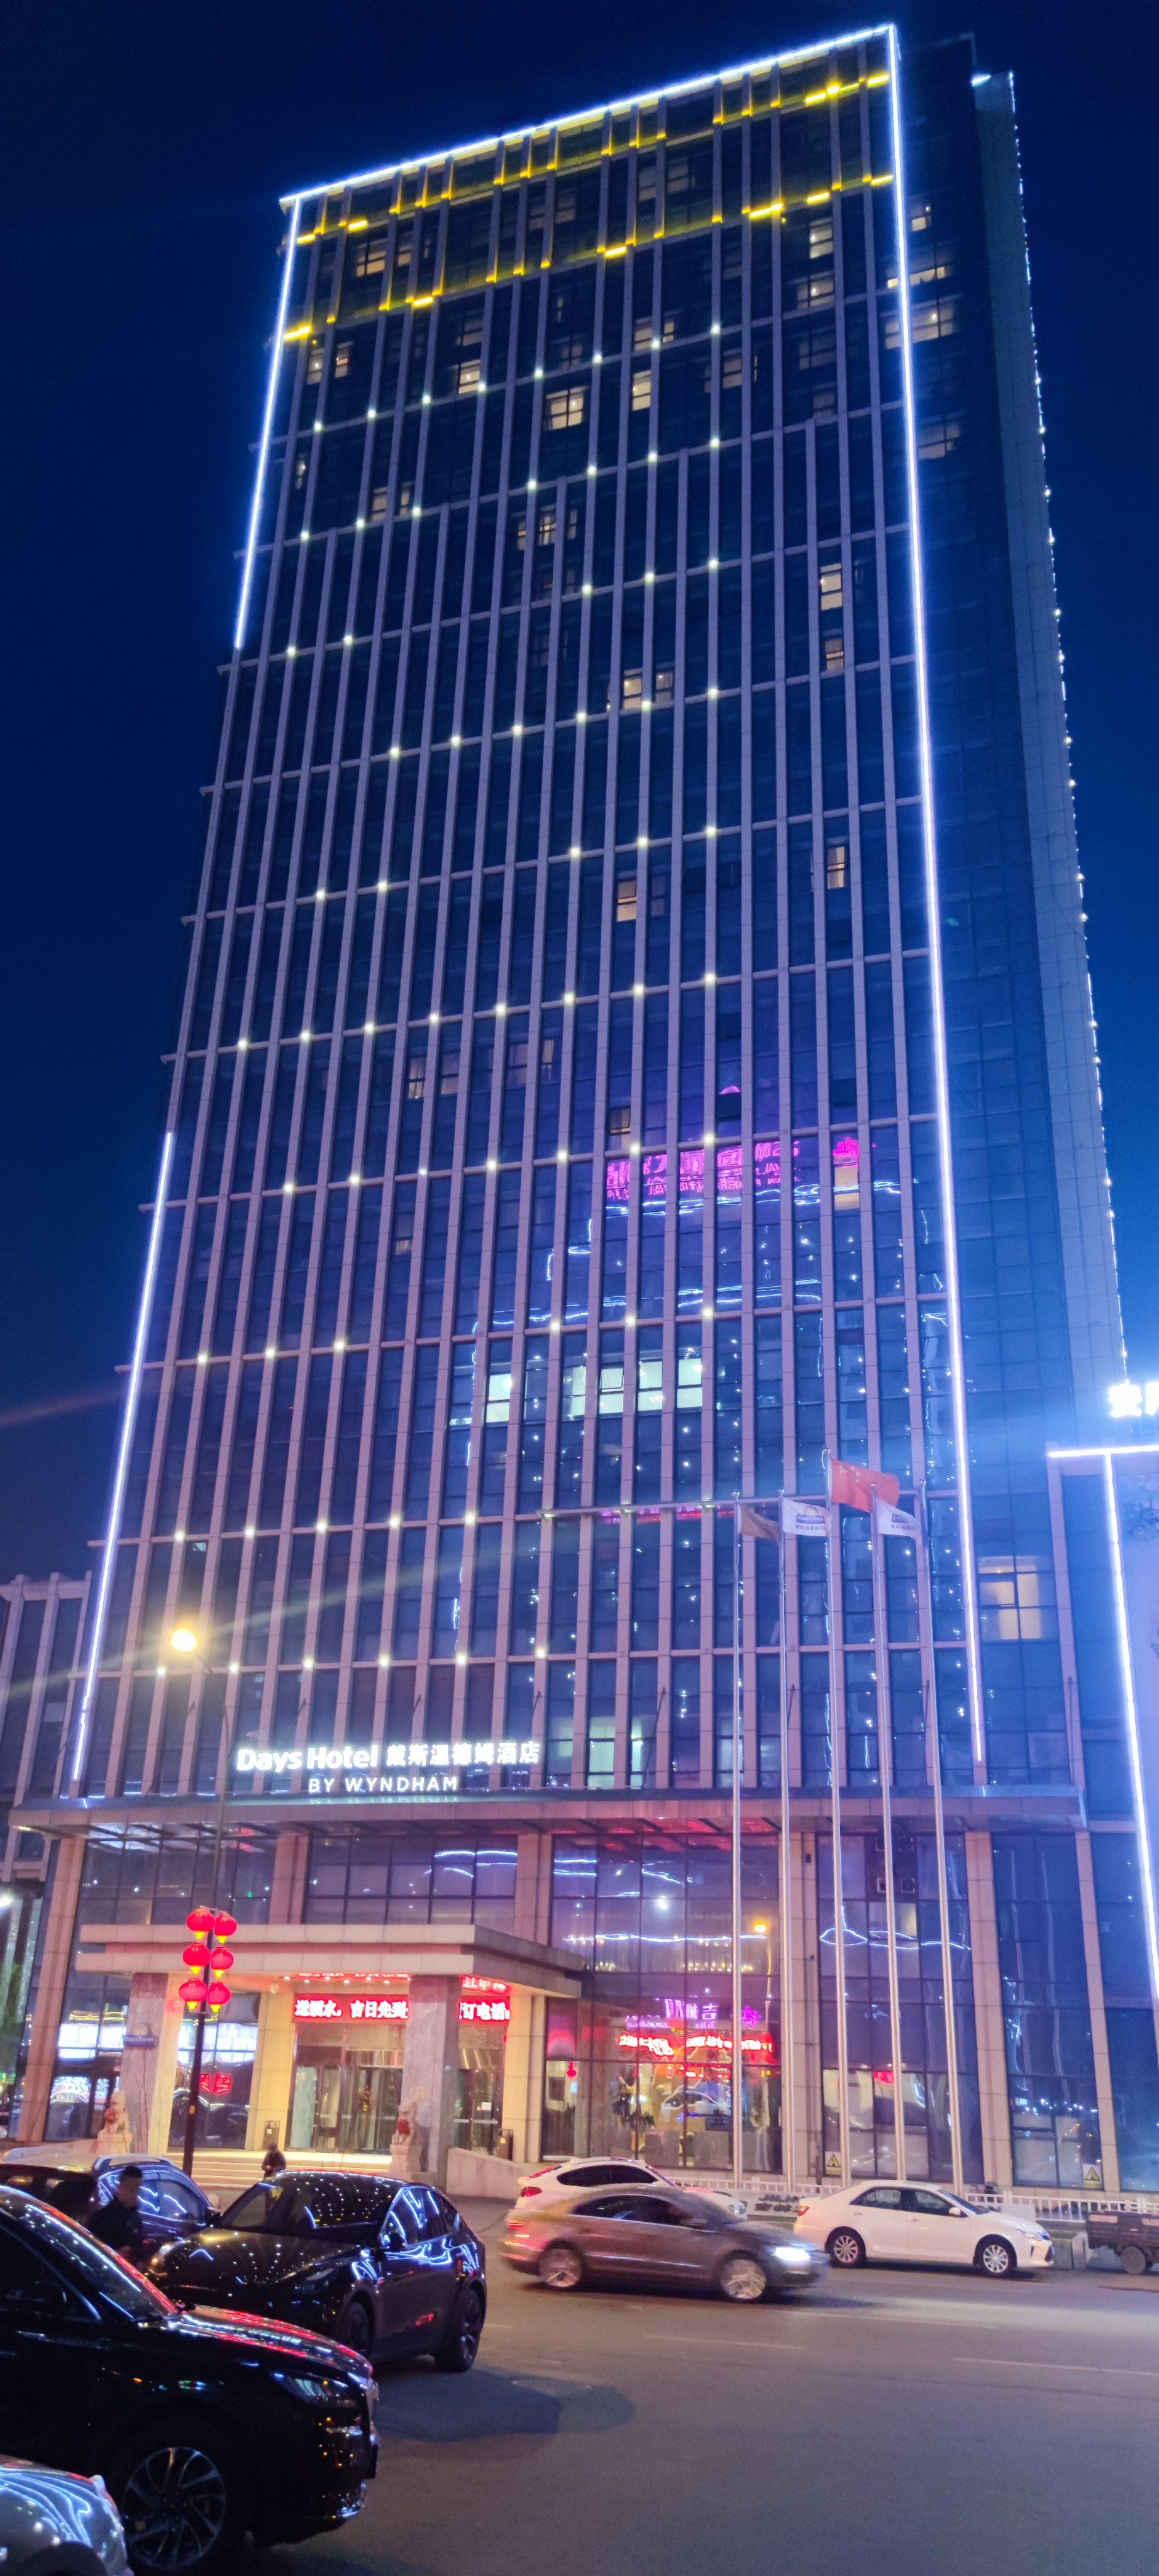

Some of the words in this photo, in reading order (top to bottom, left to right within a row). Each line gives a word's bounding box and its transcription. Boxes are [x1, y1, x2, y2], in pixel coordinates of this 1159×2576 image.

[236, 1748, 302, 1773] Days
[307, 1745, 378, 1768] Hotel
[387, 1741, 540, 1766] 戴斯温德姆酒店
[308, 1778, 335, 1792] BY
[345, 1776, 458, 1791] WYNDHAM
